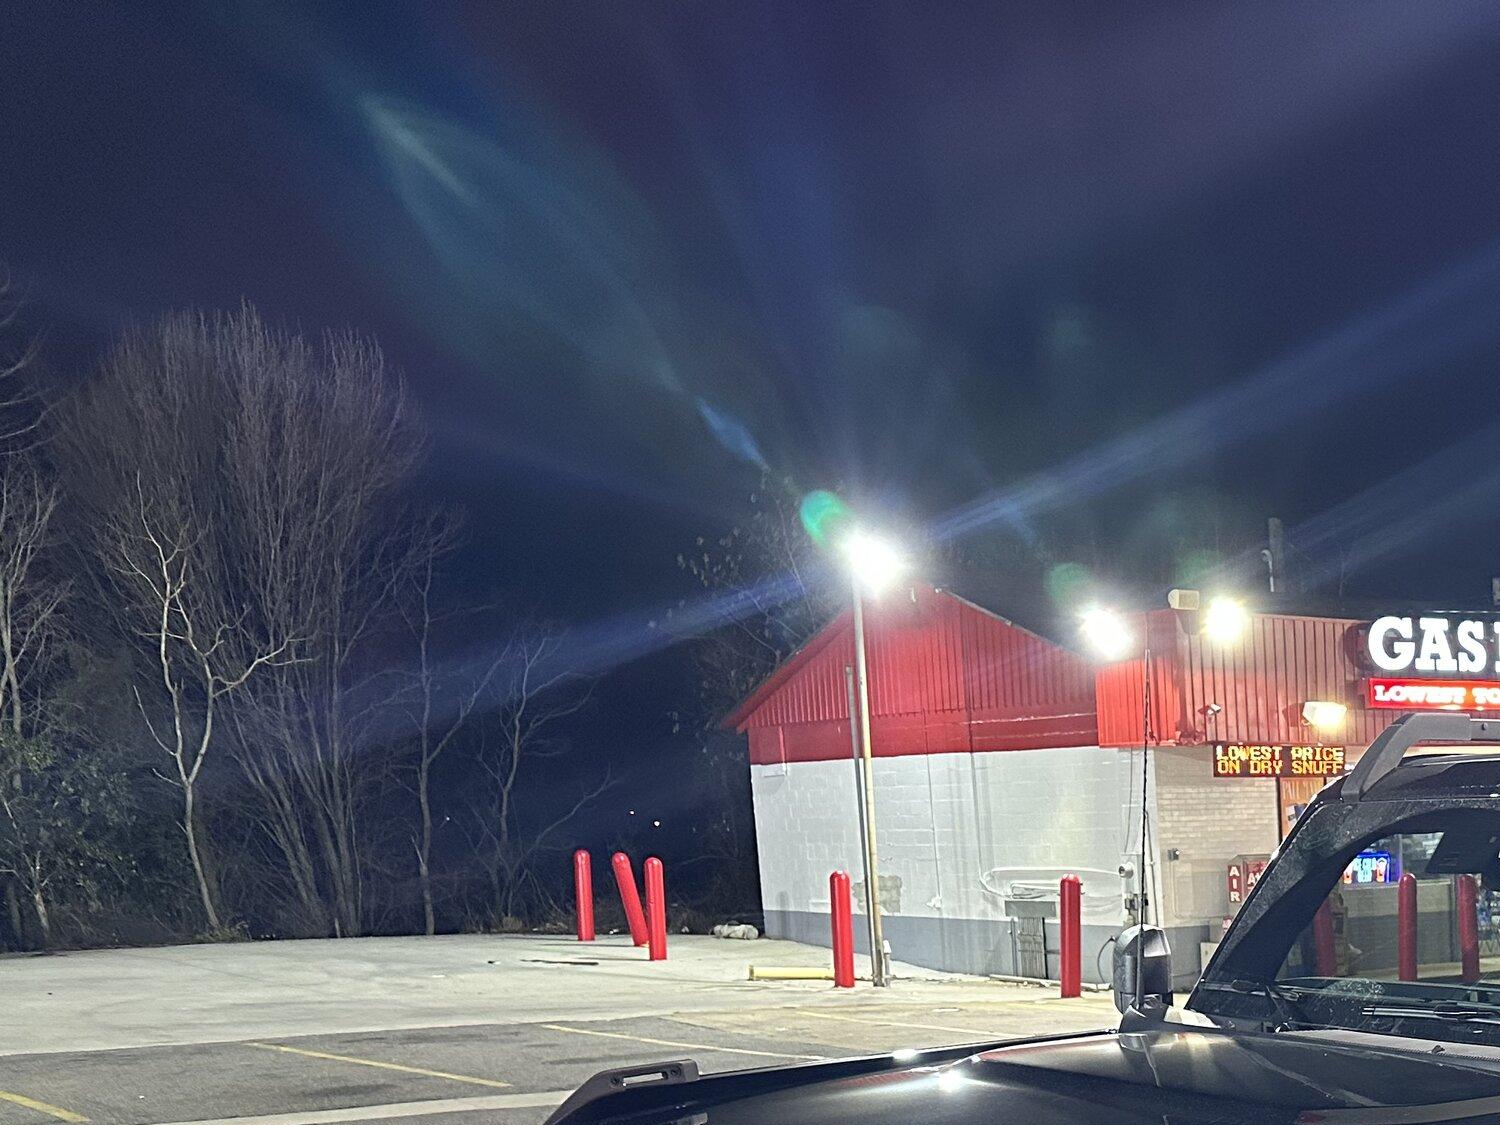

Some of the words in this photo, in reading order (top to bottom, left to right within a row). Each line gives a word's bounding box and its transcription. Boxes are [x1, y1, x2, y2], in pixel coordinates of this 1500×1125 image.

[1368, 616, 1487, 672] GAS
[1216, 745, 1282, 761] LOWEST
[1291, 746, 1343, 761] PRICE
[1217, 760, 1240, 774] ON
[1250, 760, 1282, 774] DRY
[1291, 760, 1343, 774] SNUFF
[1228, 865, 1241, 902] AIR
